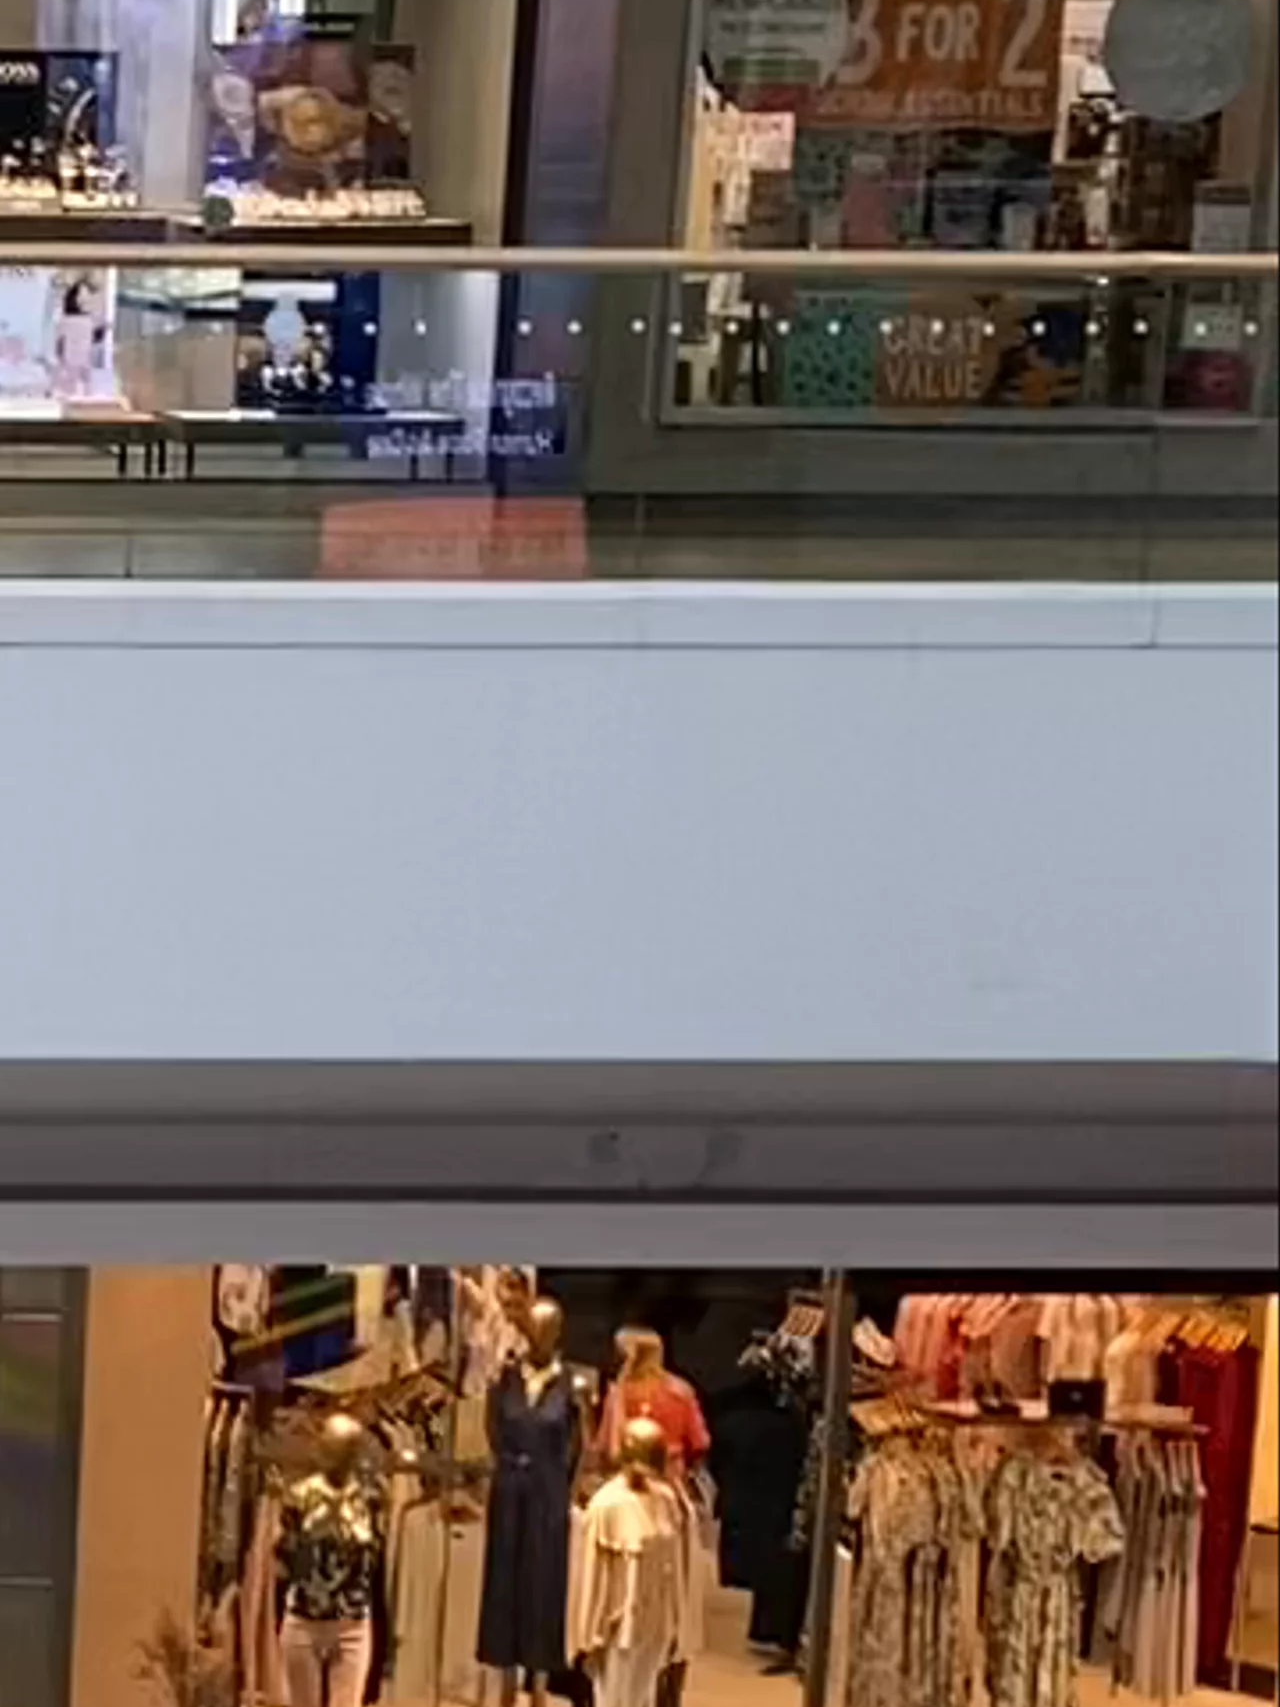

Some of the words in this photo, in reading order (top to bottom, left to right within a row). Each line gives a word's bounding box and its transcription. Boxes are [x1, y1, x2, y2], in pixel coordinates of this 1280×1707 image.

[896, 1, 981, 63] FOR
[884, 315, 984, 353] GREAT
[885, 359, 984, 399] VALUE
